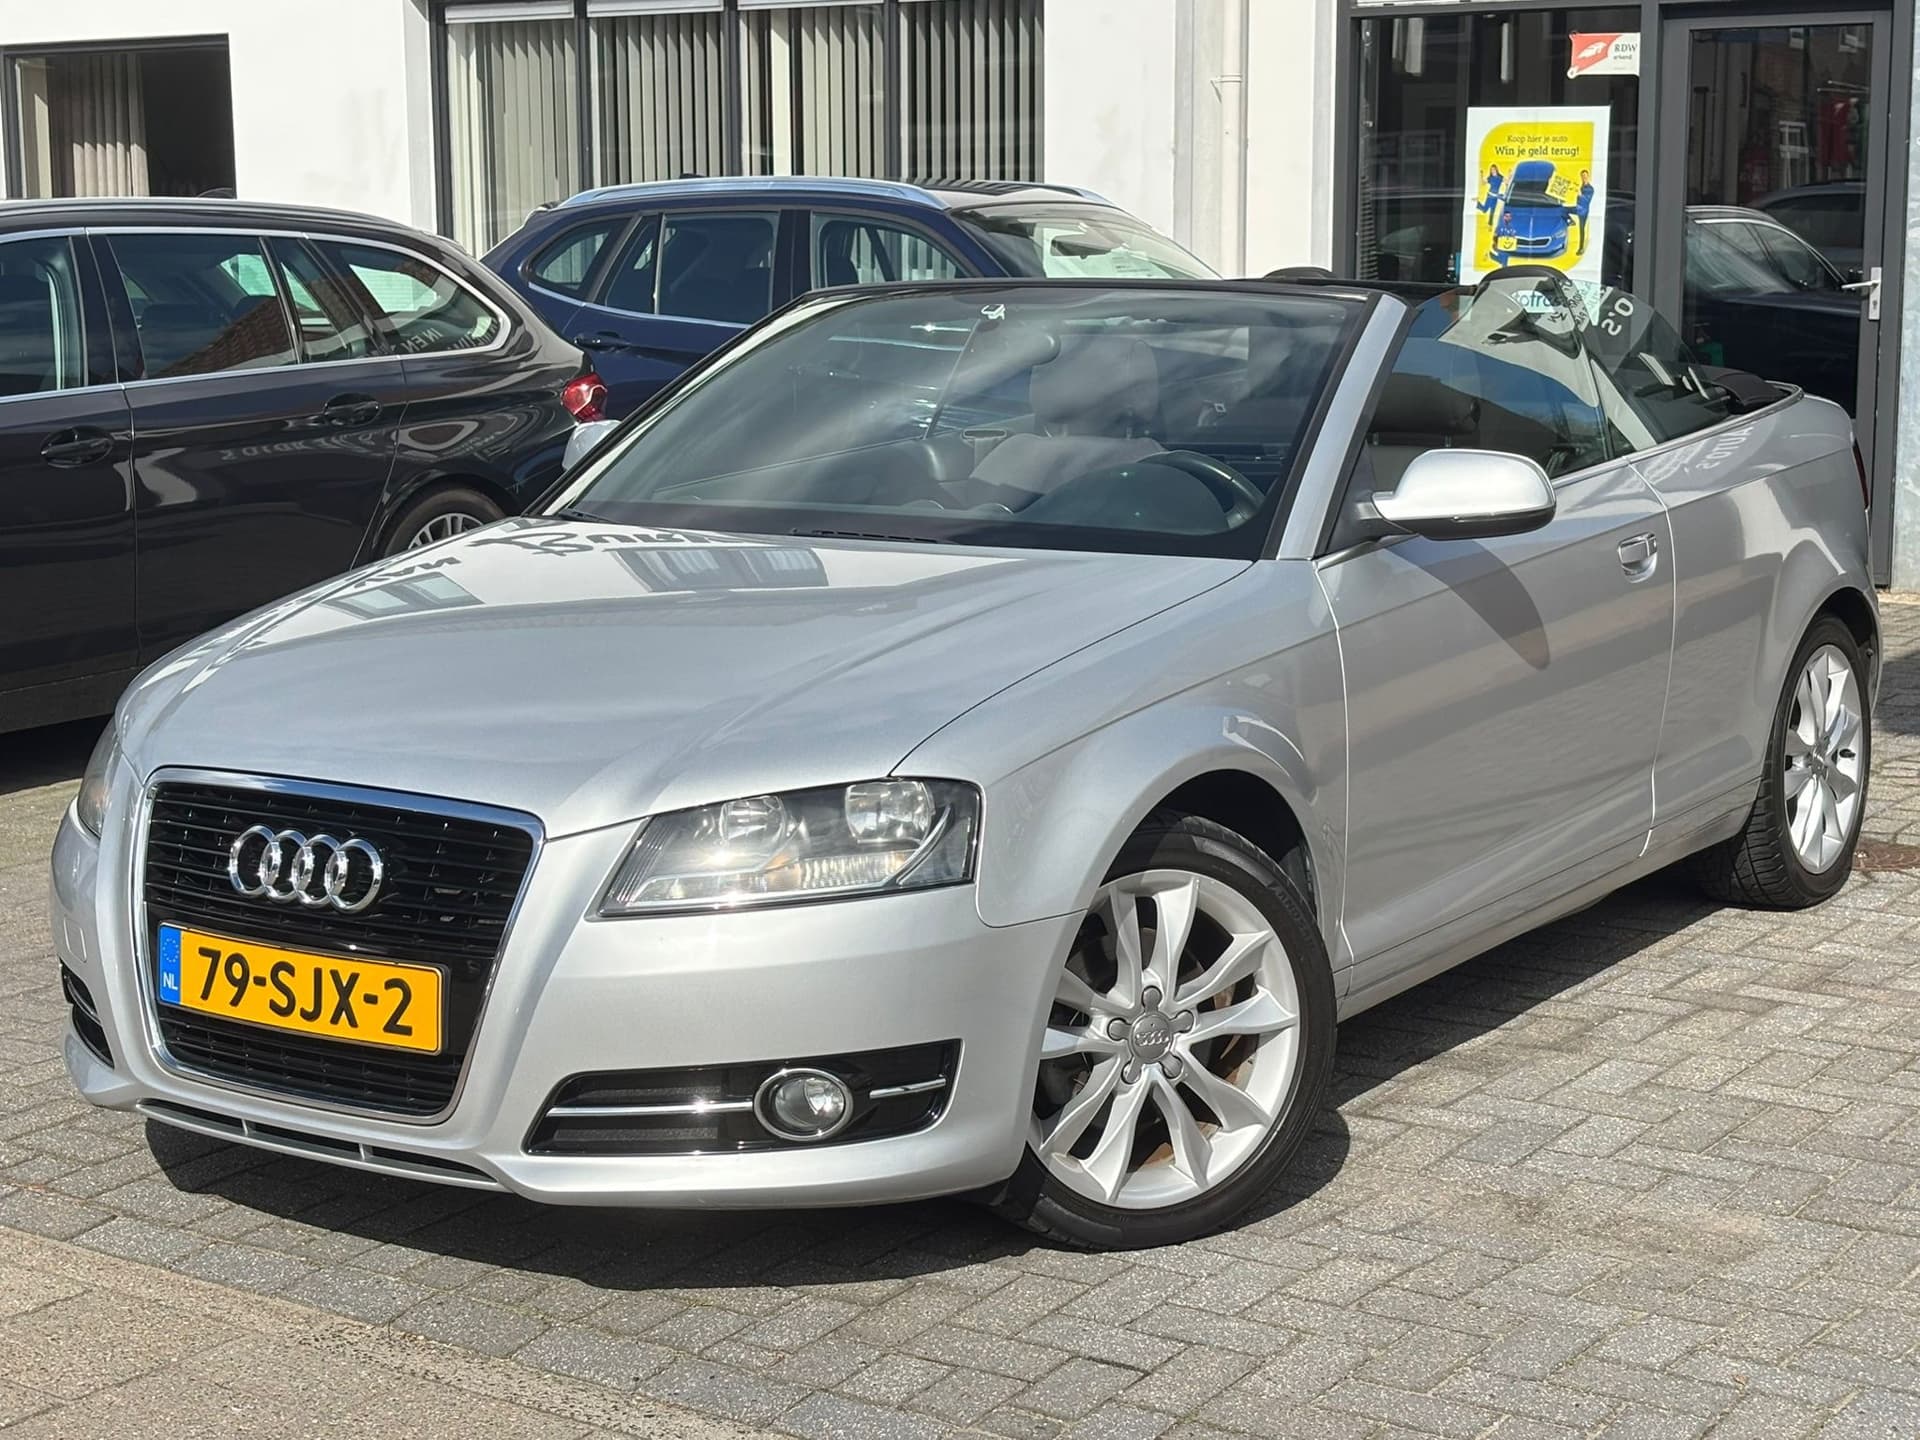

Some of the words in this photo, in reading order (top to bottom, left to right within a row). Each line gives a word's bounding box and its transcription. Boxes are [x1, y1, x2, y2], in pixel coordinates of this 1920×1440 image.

[1614, 43, 1638, 53] RDW
[1507, 135, 1526, 144] Koop
[1527, 135, 1541, 143] hier
[1543, 135, 1550, 144] je
[1552, 135, 1568, 143] auto
[1495, 146, 1515, 155] Win
[1517, 146, 1526, 157] je
[1528, 146, 1548, 157] geld
[1551, 146, 1580, 157] terug!
[163, 971, 178, 990] NL
[198, 945, 413, 1037] 79-SJX-2
